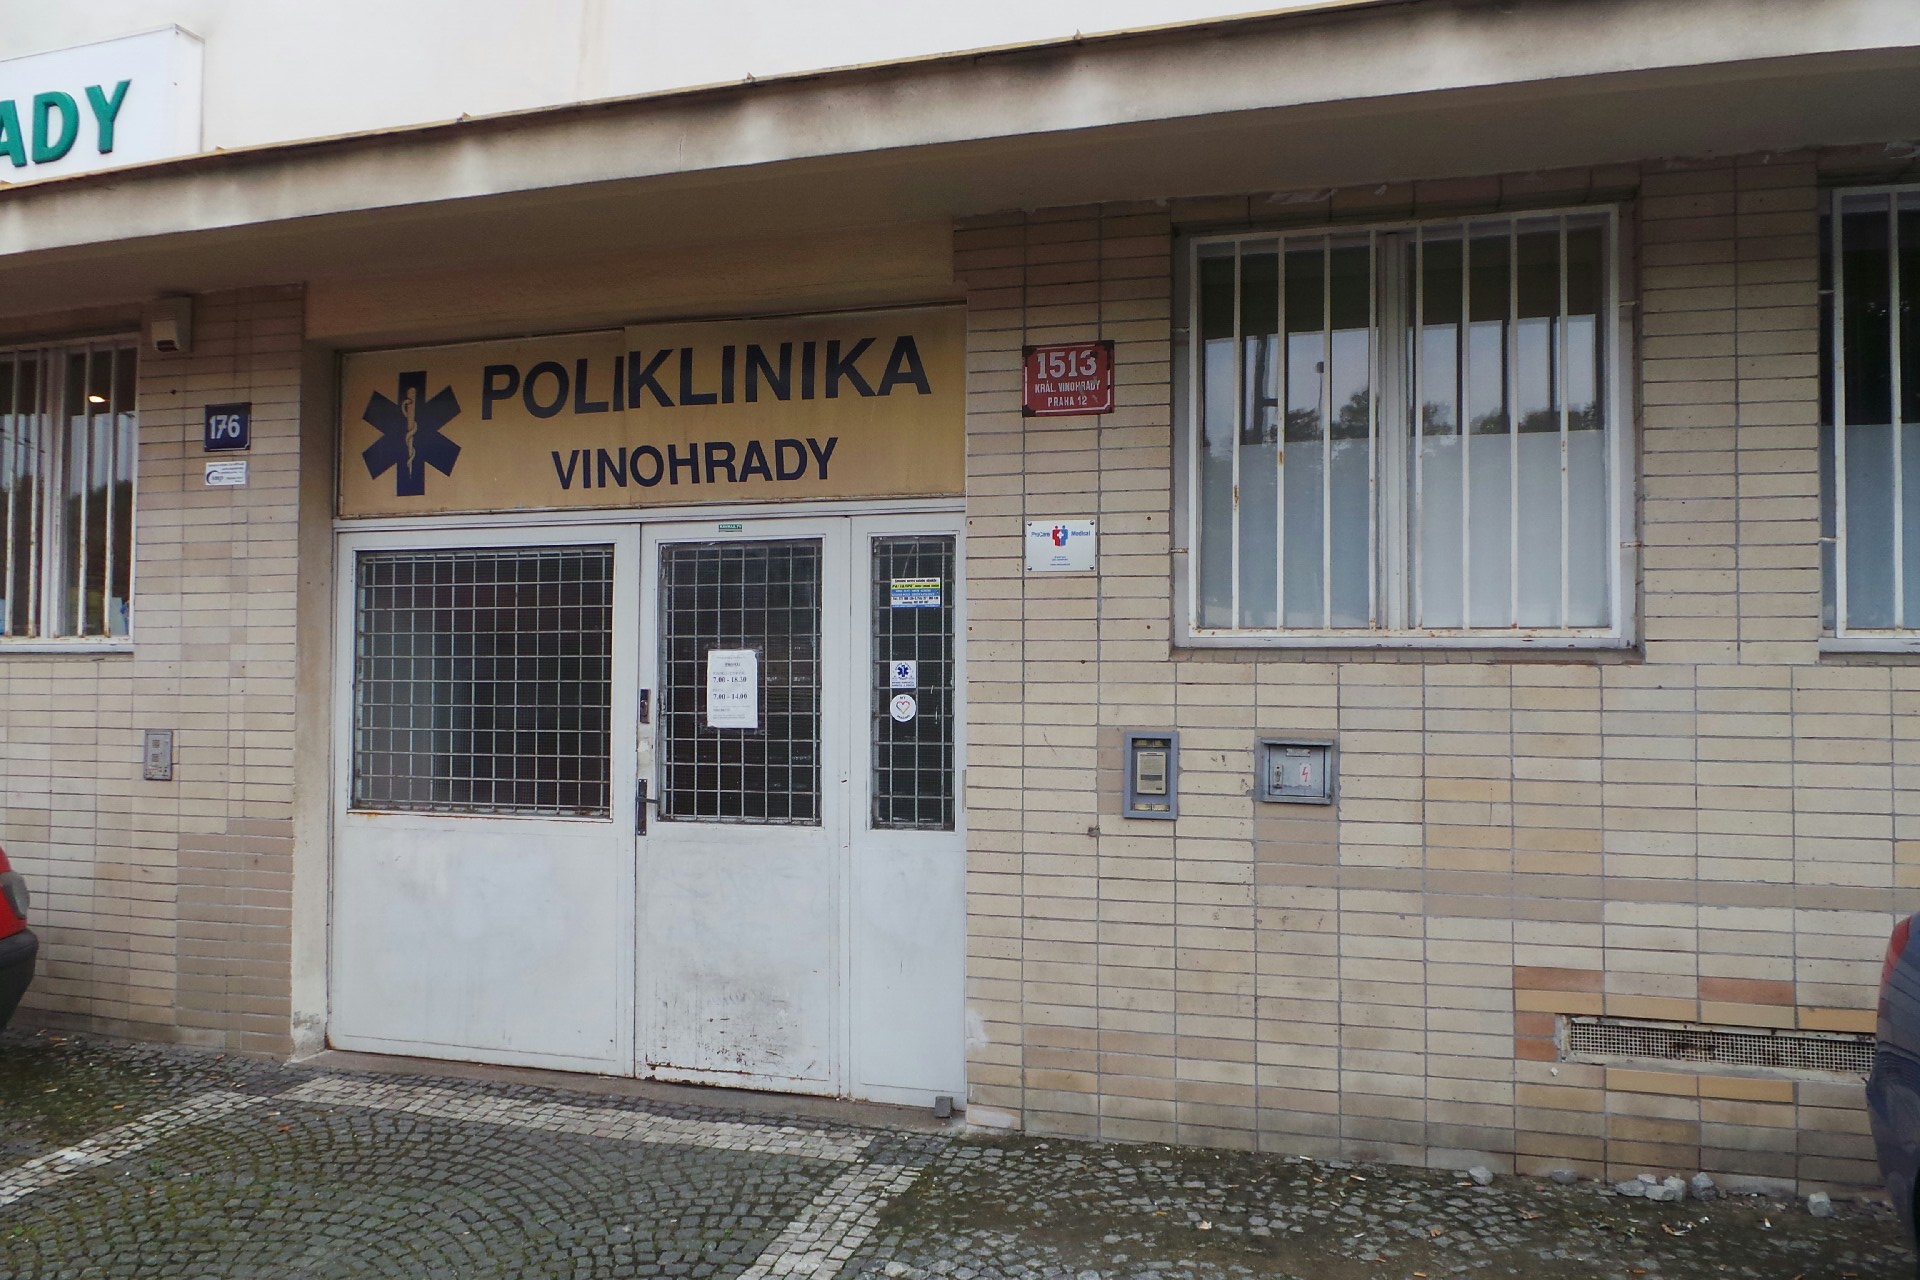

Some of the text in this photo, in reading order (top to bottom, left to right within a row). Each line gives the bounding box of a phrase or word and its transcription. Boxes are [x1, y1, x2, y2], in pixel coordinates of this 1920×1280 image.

[481, 335, 932, 420] POLIKLINIKA
[1036, 349, 1097, 379] 1513
[1034, 380, 1056, 393] KRÁL.
[1047, 395, 1088, 407] PRAHA 12
[209, 414, 241, 440] 176
[551, 436, 838, 490] VINOHRADY
